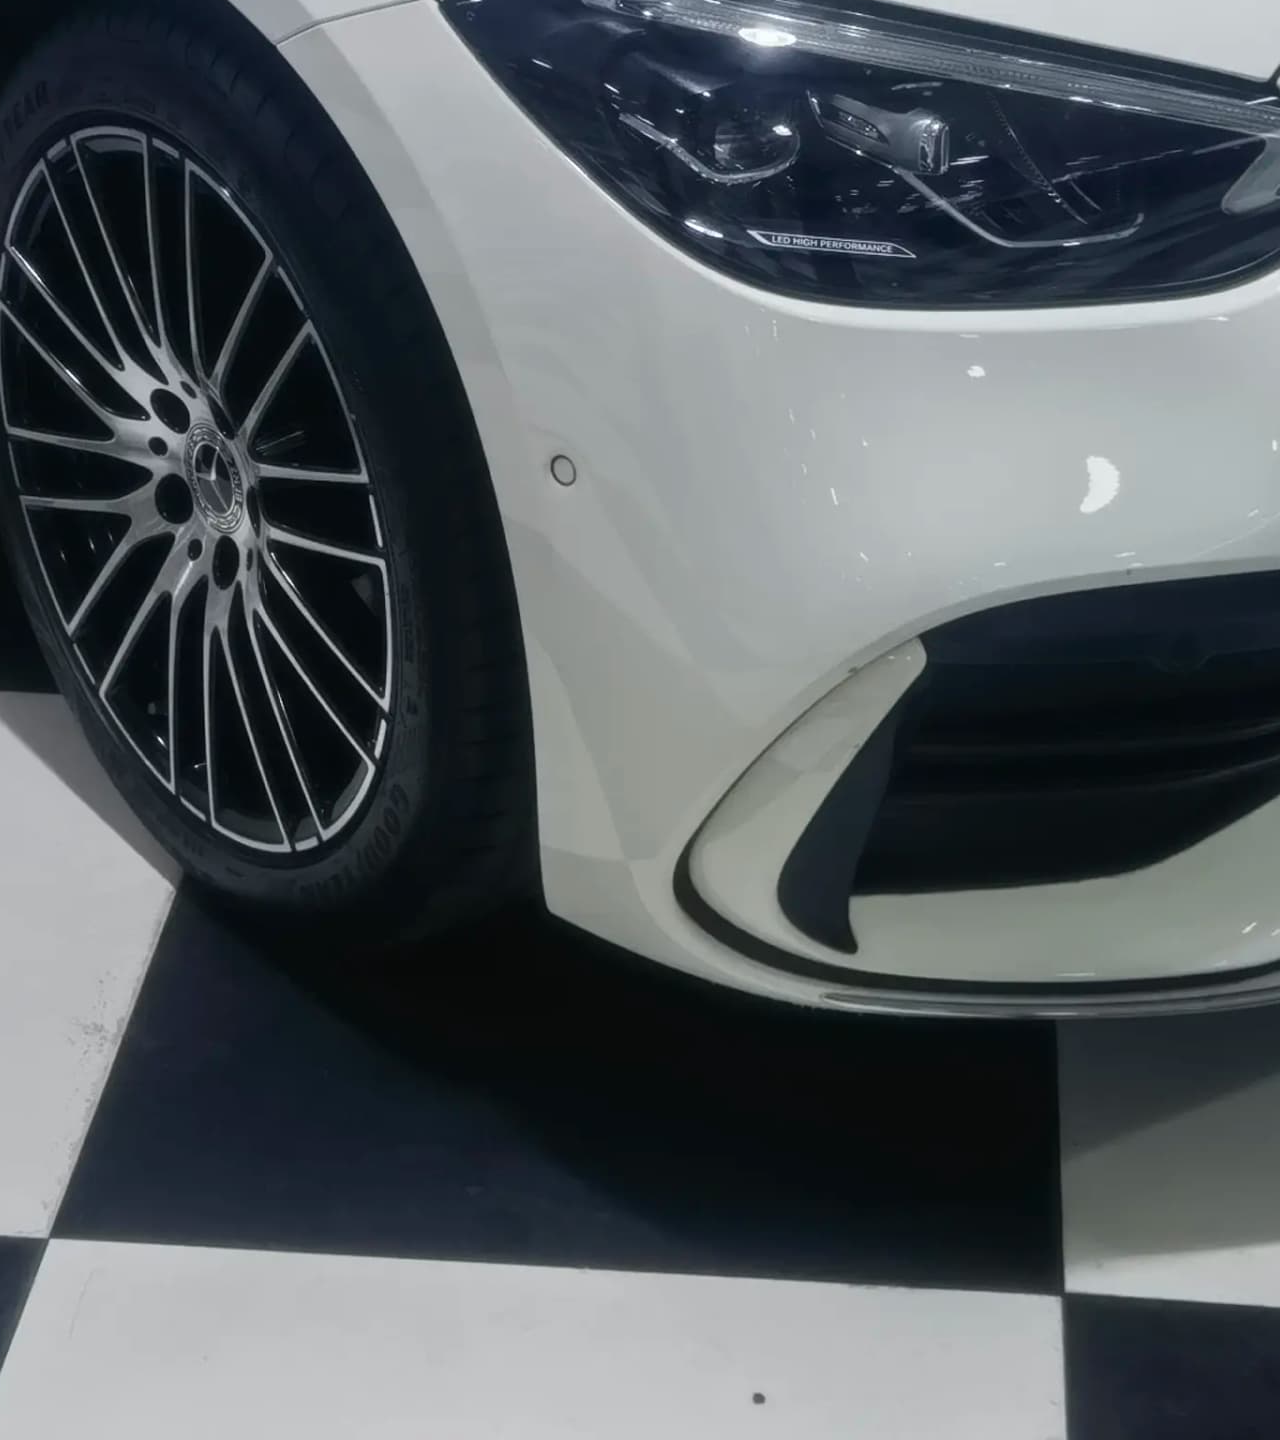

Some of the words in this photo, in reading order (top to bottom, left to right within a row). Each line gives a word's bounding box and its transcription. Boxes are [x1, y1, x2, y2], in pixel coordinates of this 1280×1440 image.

[771, 234, 791, 245] LED
[792, 236, 818, 248] HIGH
[819, 239, 893, 253] PERFORMANCE
